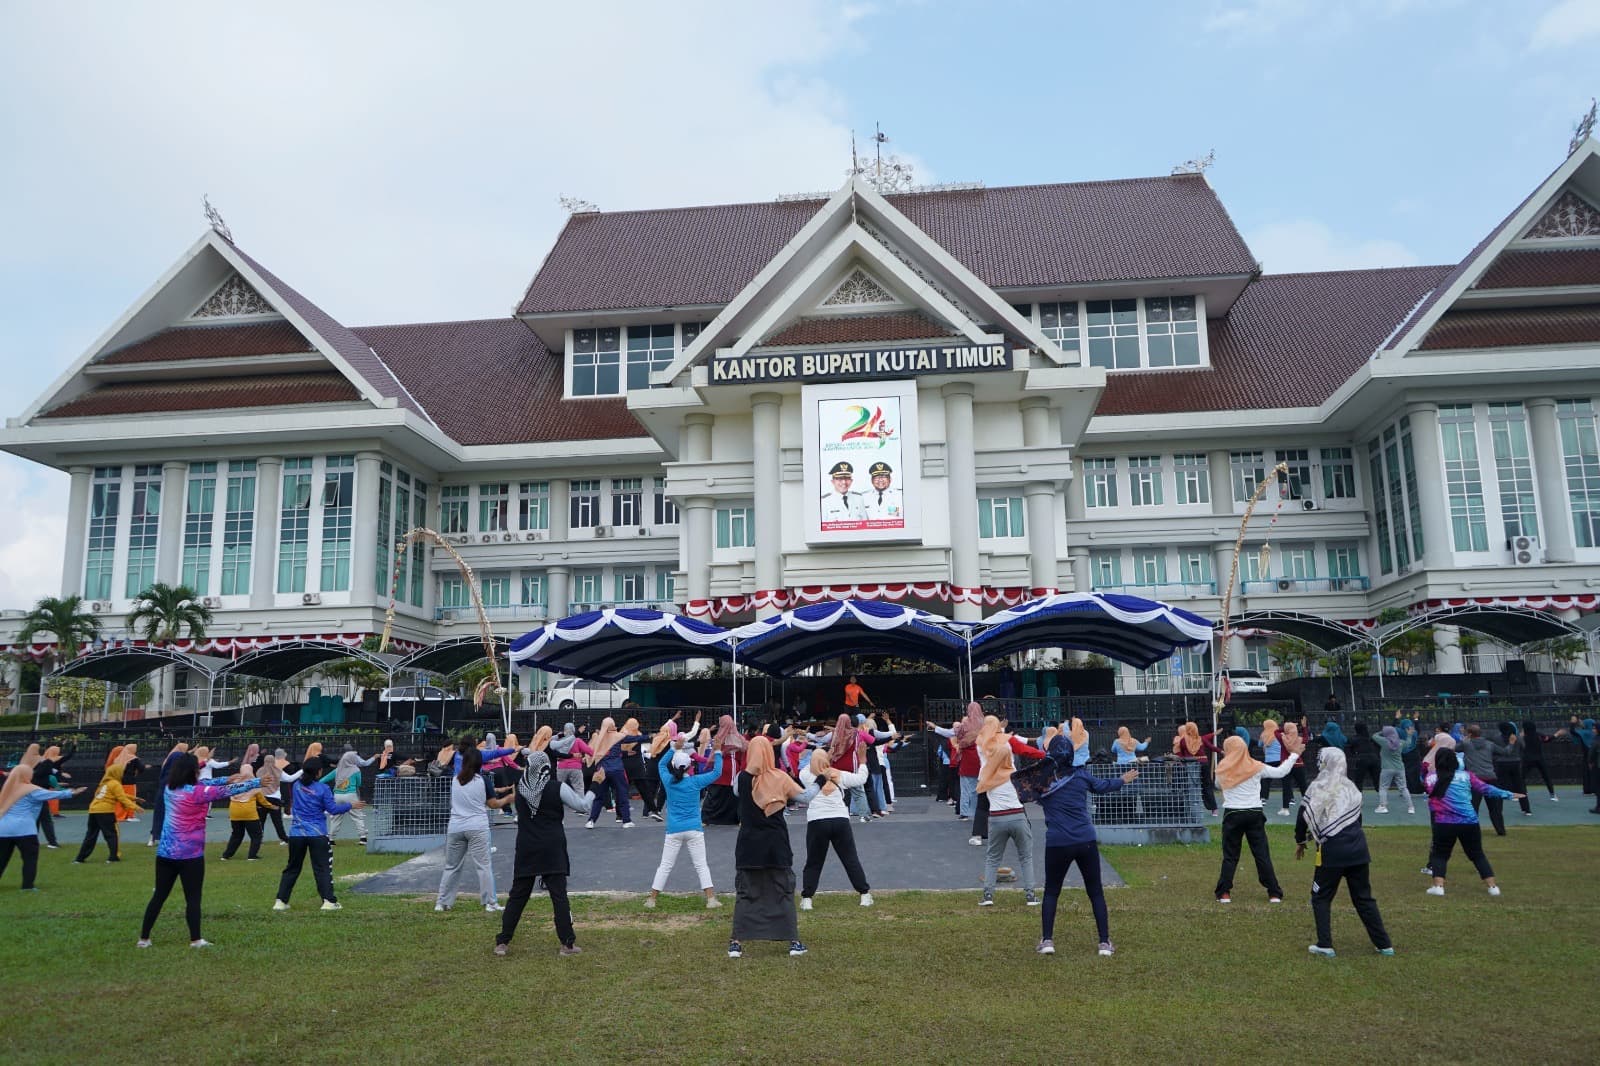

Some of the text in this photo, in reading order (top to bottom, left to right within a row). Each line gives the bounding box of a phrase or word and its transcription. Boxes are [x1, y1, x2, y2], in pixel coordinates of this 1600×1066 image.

[713, 346, 1006, 380] KANTOR BUPATI KUTAI TIMUR
